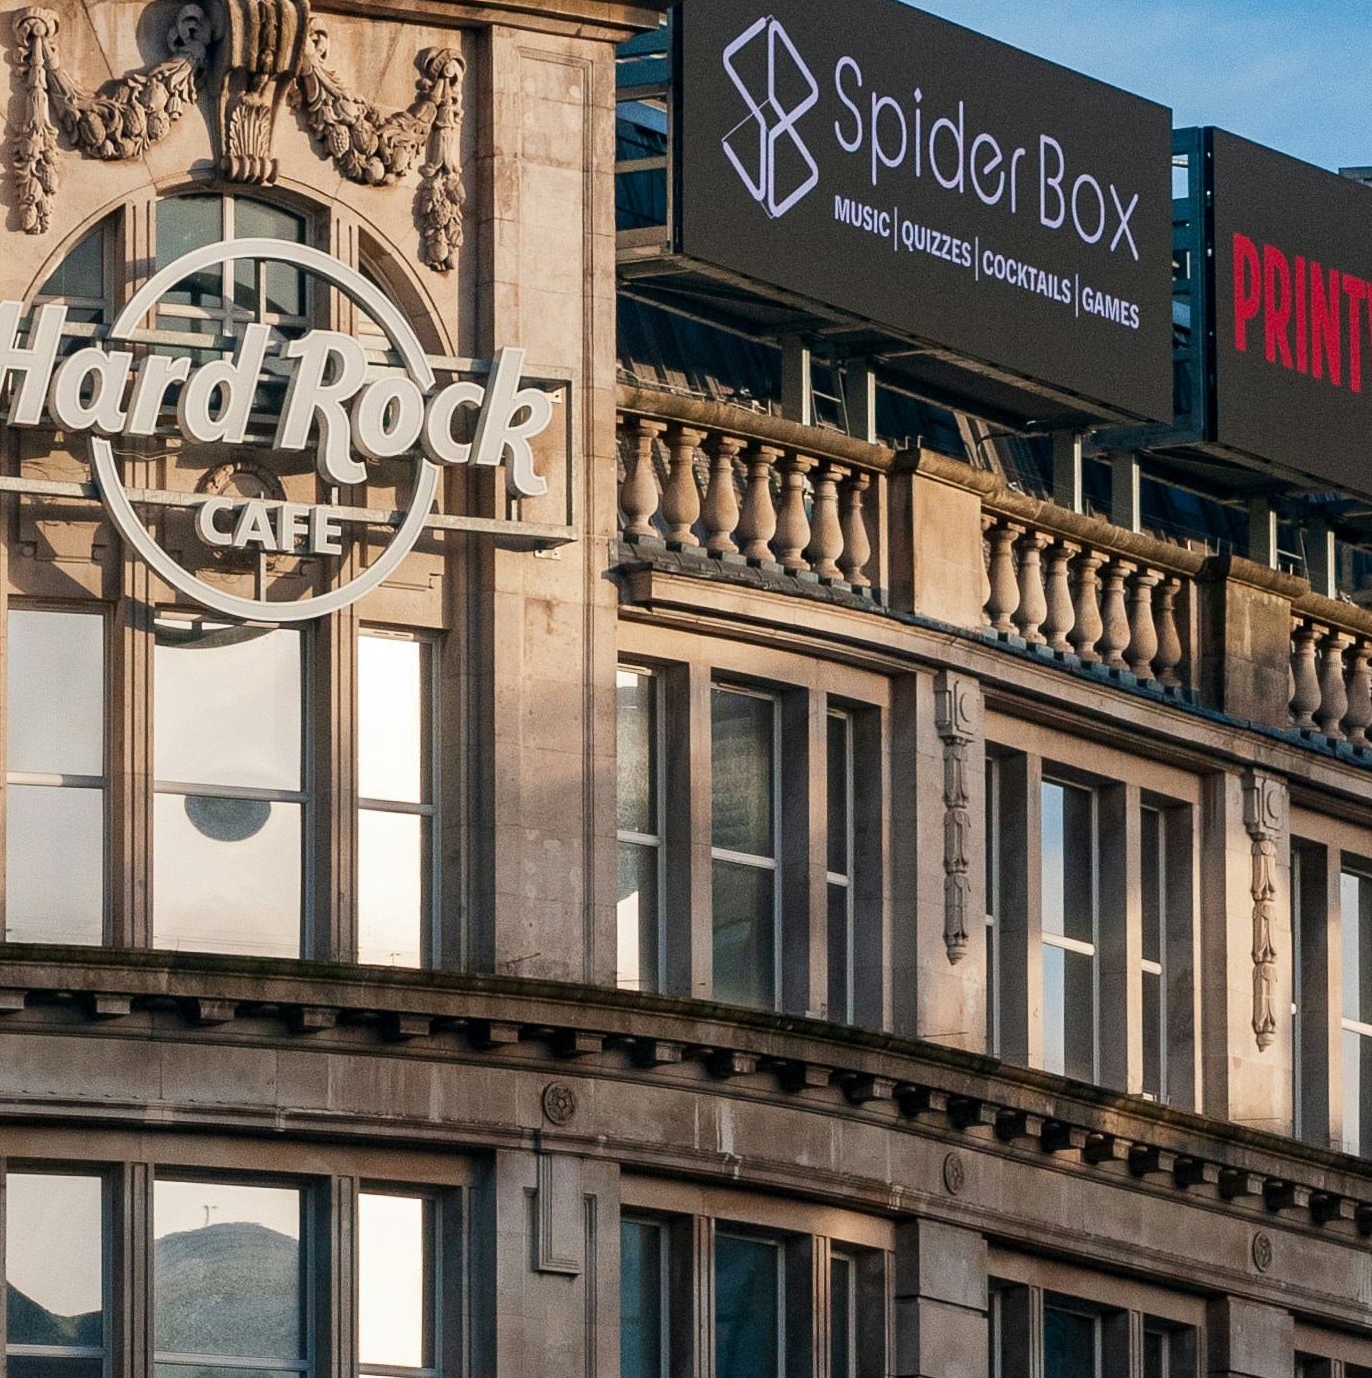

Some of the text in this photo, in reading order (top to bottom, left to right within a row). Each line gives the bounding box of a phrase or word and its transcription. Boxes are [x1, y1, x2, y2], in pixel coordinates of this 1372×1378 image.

[834, 55, 1139, 261] Spider Box
[834, 194, 1140, 329] MUSIC QUIZZES COCKTAILS GAMES
[1233, 232, 1372, 396] PRINT
[273, 328, 554, 497] Rock
[194, 496, 343, 557] CAFE
